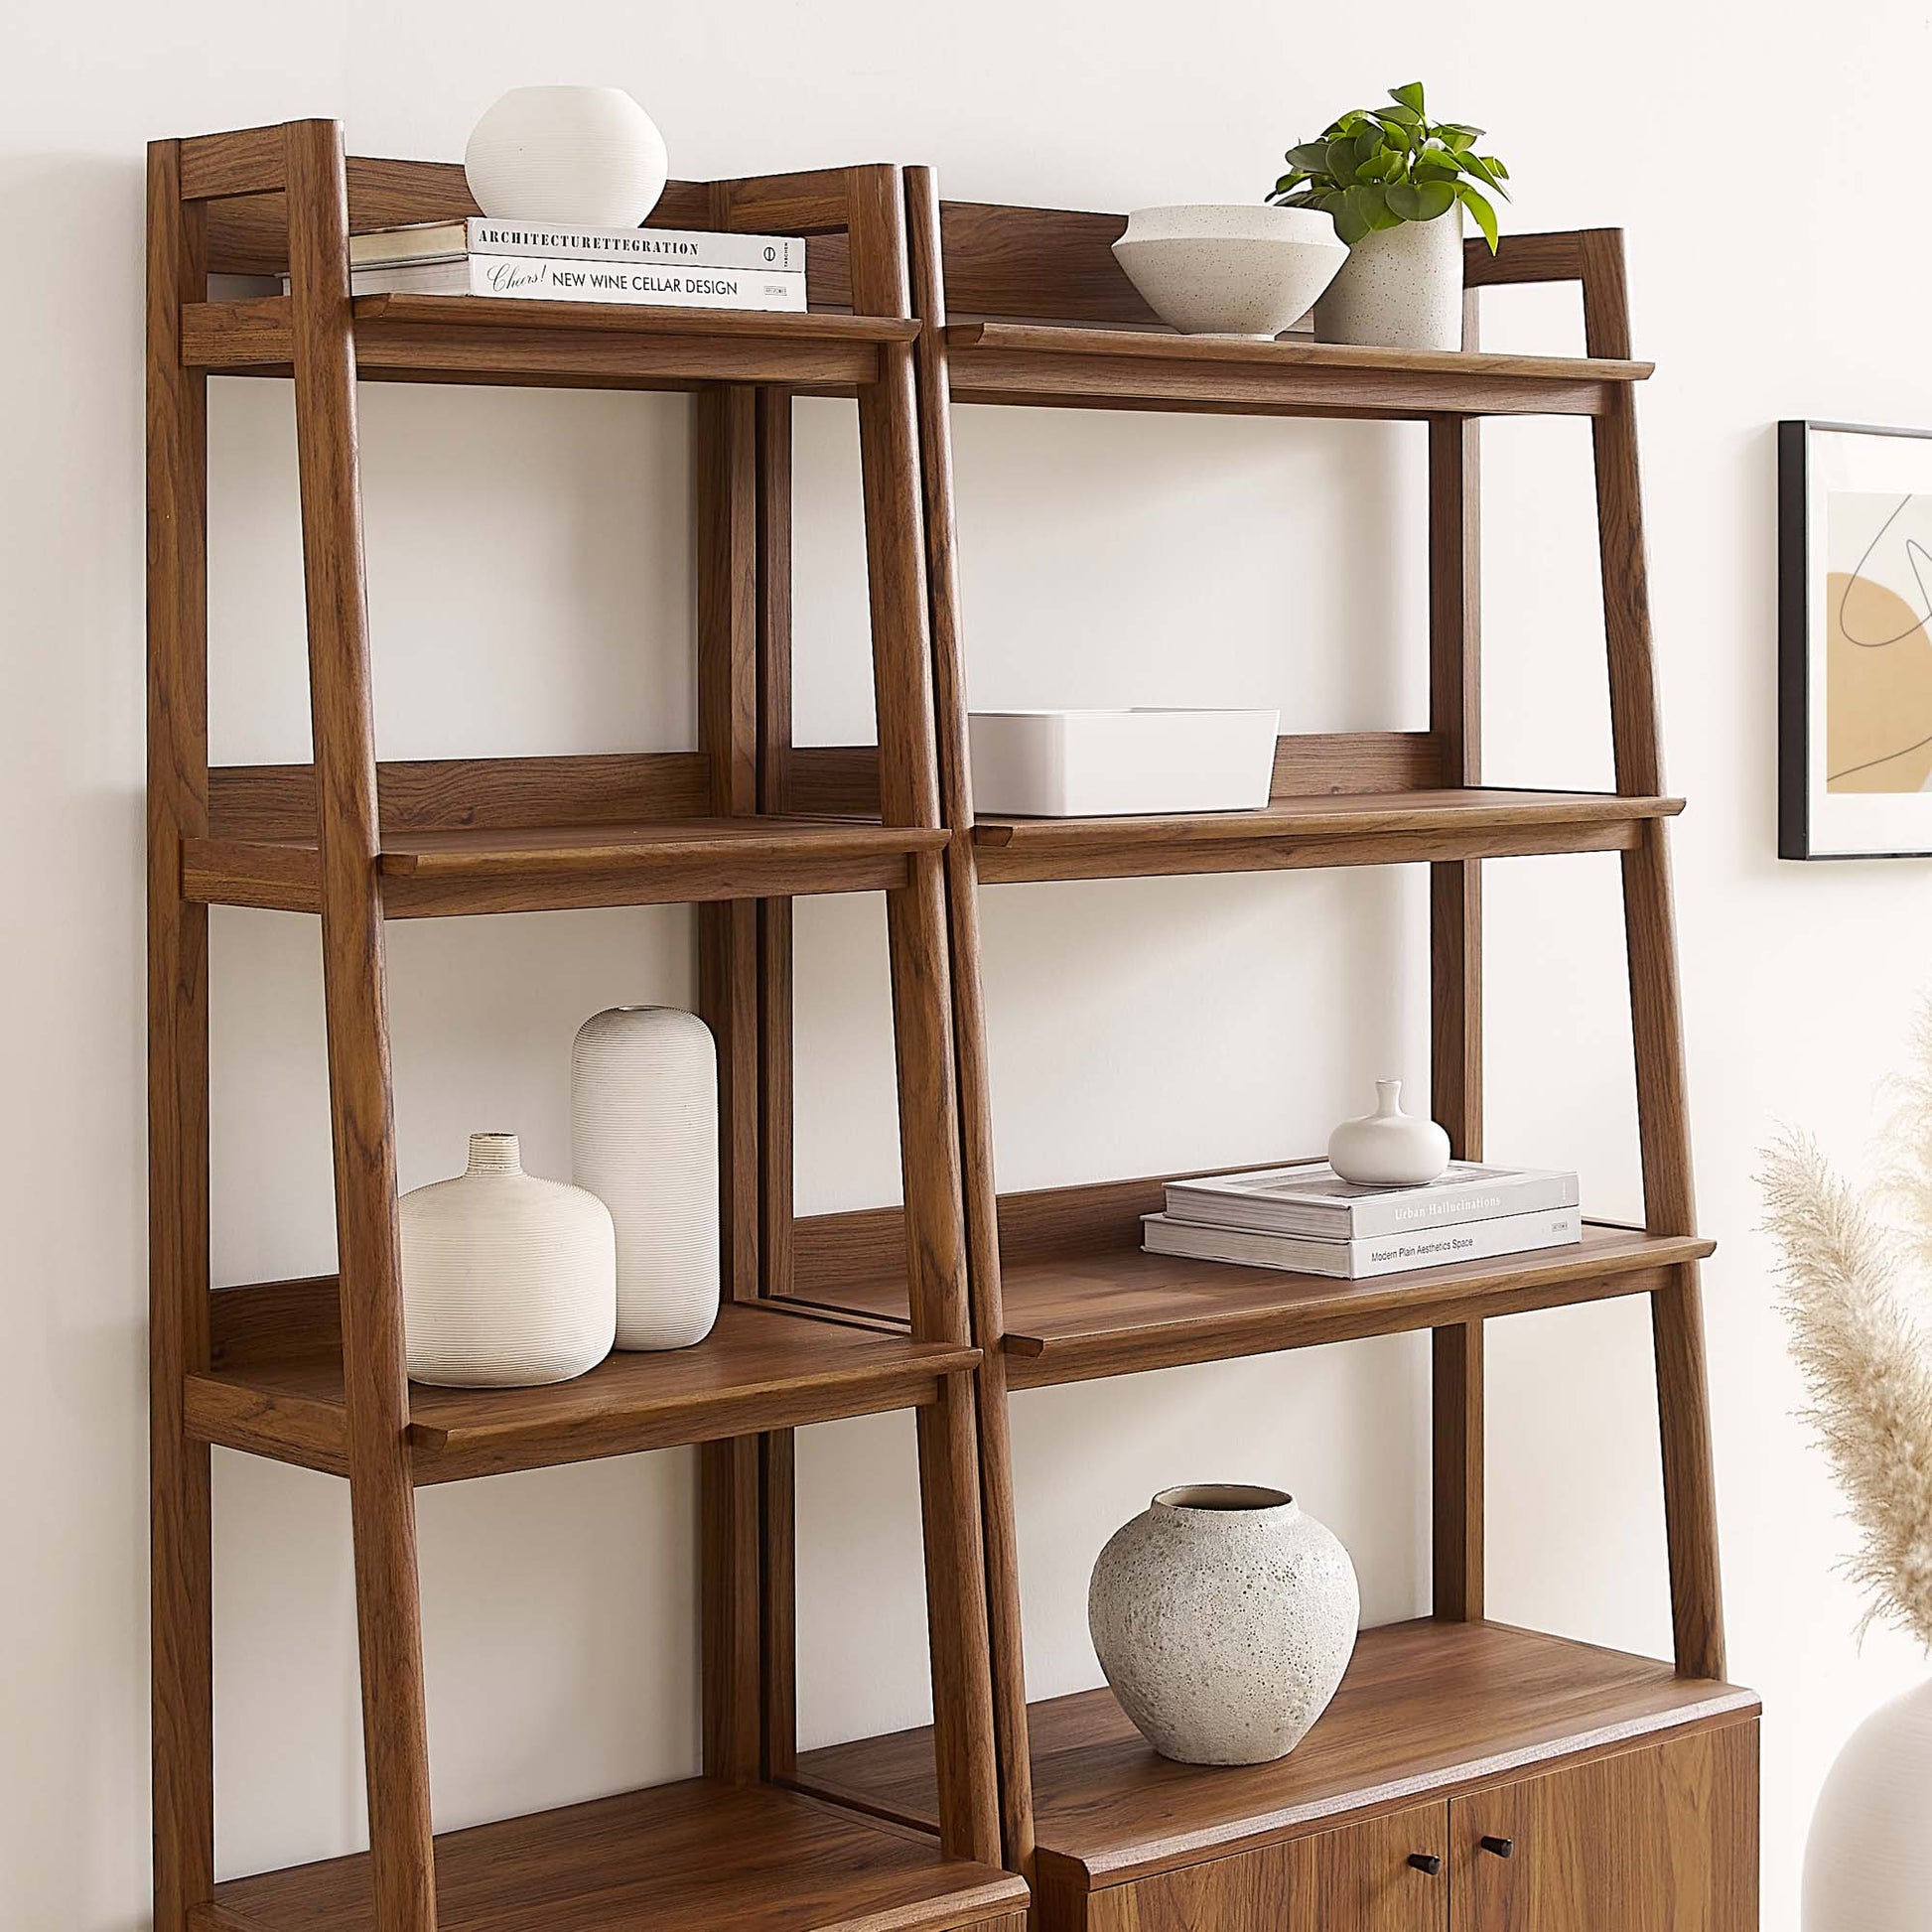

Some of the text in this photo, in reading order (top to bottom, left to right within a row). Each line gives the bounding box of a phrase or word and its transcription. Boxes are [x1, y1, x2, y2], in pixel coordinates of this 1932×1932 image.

[479, 229, 699, 255] ARCHITECTURETTEGRATION
[486, 262, 738, 296] Cheers! NEW WINE CELLAR DESIGN
[1394, 1196, 1501, 1222] Urban Hallucinations
[1371, 1237, 1473, 1262] Modern Plain Aesthetics Space
